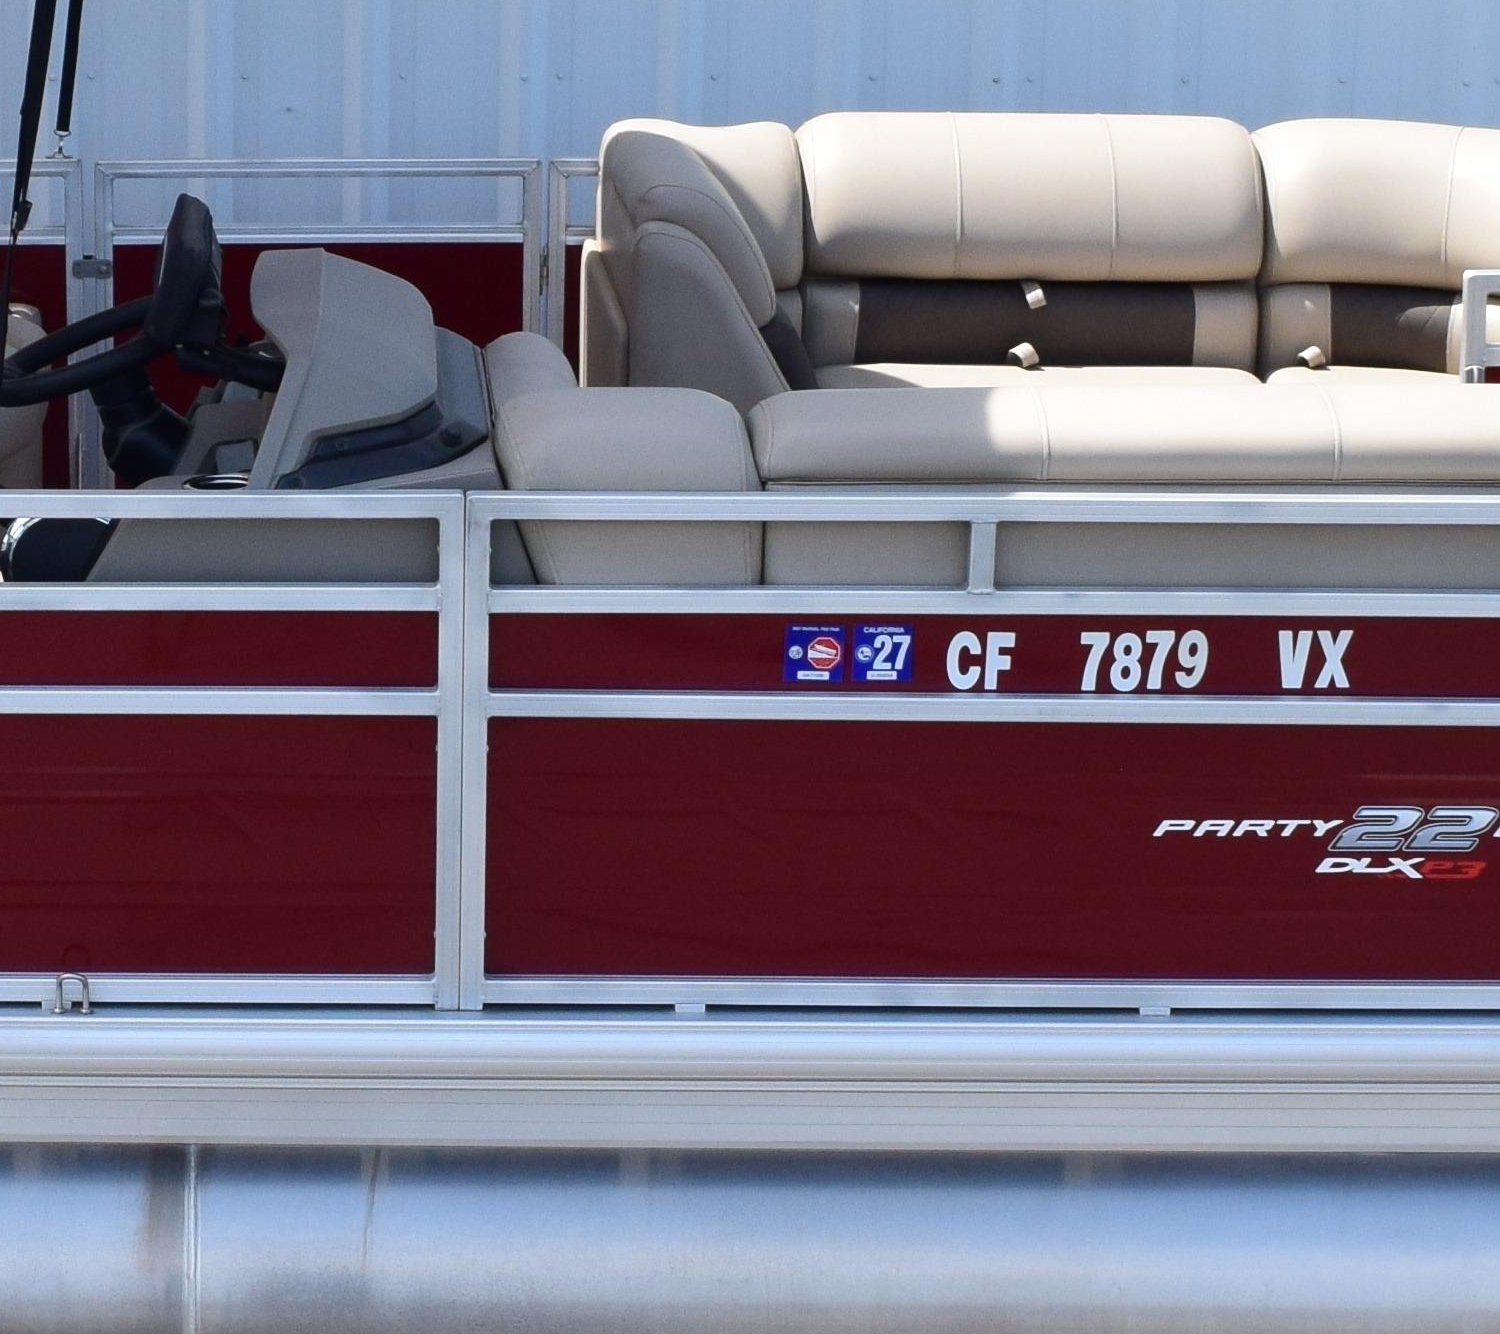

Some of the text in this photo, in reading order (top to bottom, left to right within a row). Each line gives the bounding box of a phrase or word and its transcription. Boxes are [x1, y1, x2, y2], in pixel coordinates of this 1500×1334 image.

[872, 634, 912, 670] 27
[946, 629, 1354, 692] CF 7879 VX
[1152, 819, 1344, 837] PARTY
[1327, 805, 1499, 852] 22
